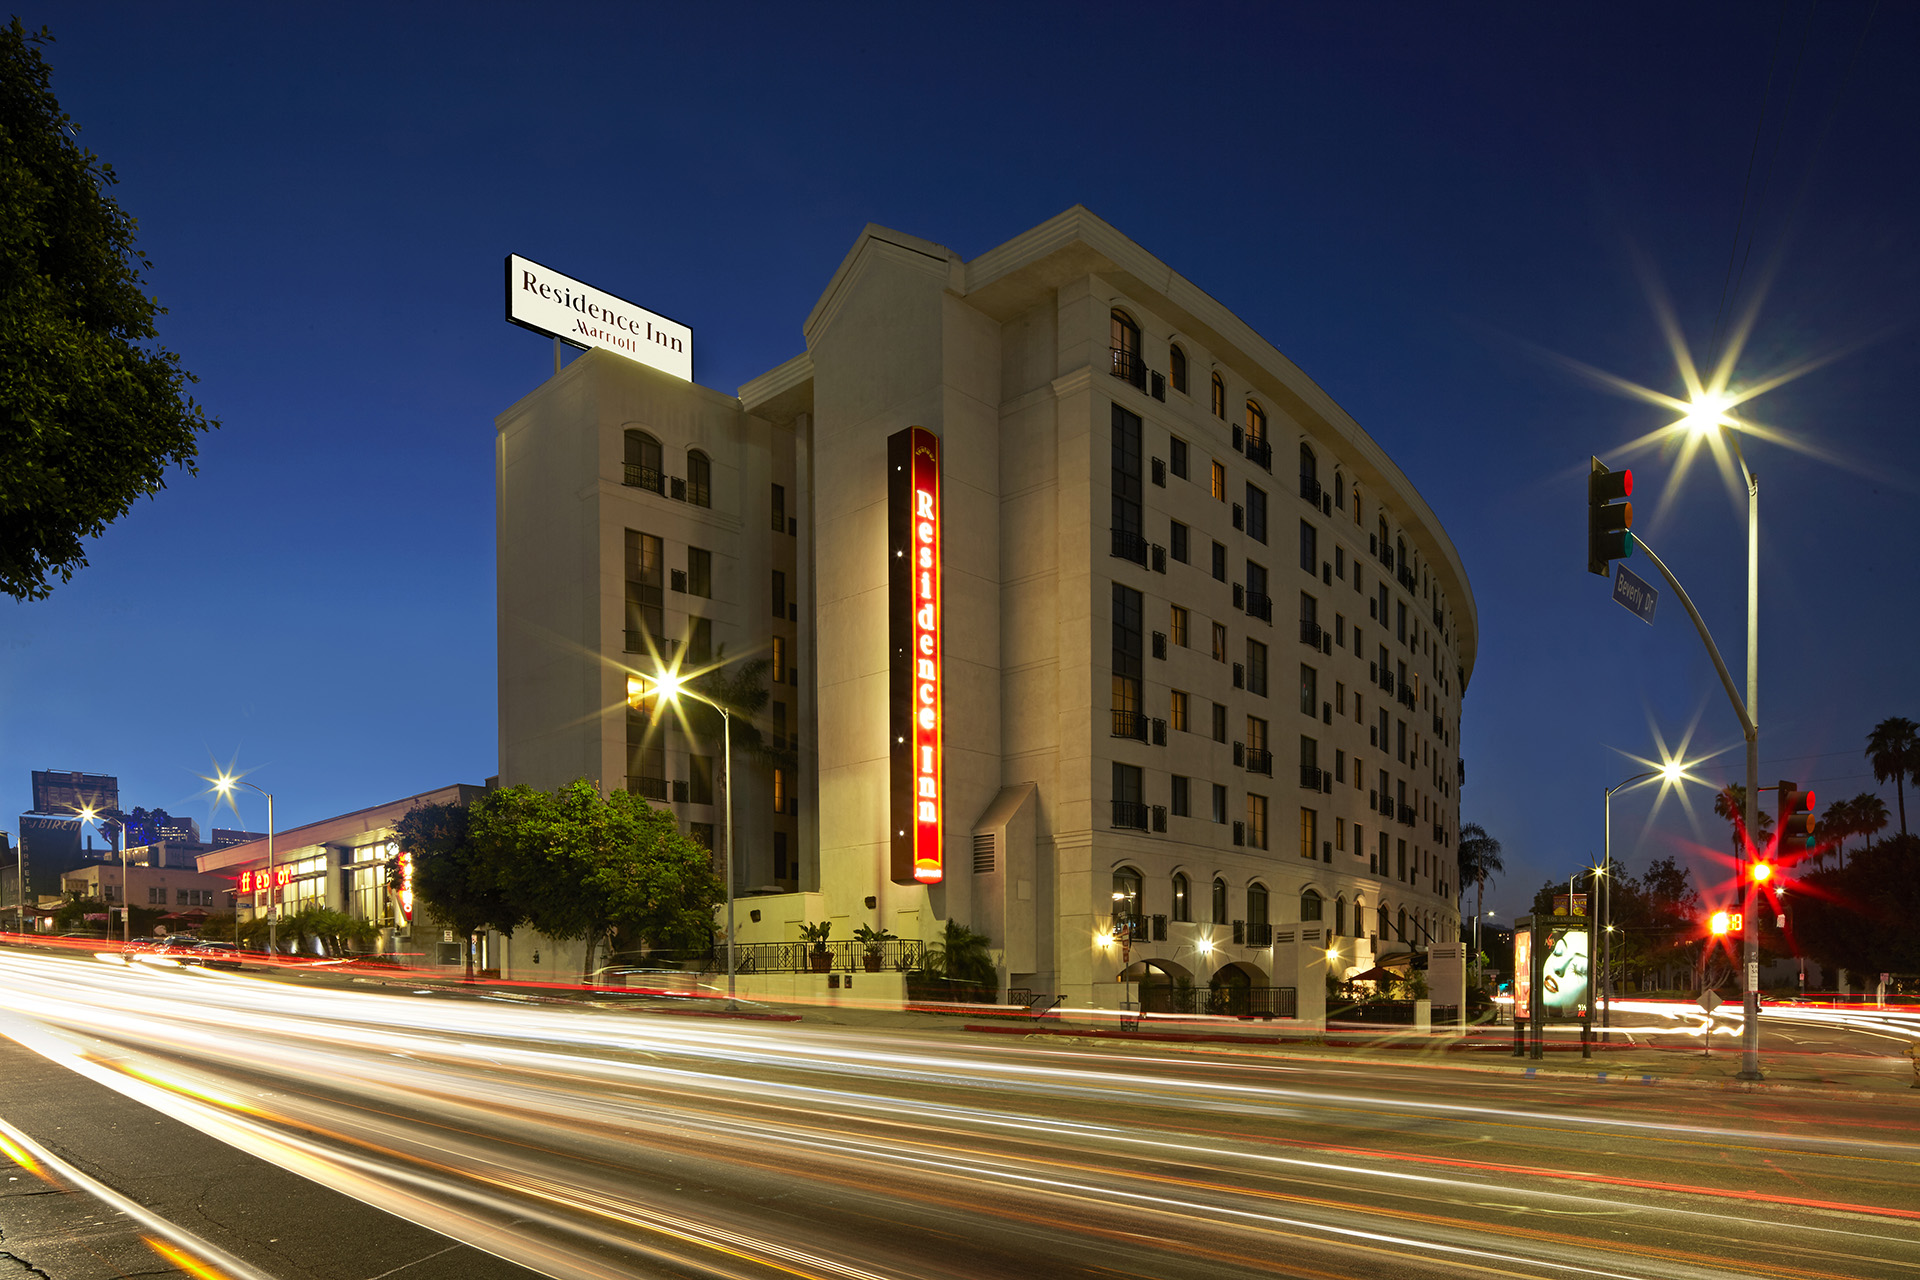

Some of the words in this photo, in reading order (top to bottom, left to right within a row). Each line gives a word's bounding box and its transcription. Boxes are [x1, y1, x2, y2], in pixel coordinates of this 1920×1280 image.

[522, 269, 640, 336] Residence
[646, 321, 684, 354] Inn
[571, 318, 637, 353] Marriott
[916, 489, 936, 730] Residence
[1617, 573, 1644, 610] Beverly
[1644, 592, 1654, 613] Dr
[918, 746, 937, 823] Inn
[22, 837, 31, 893] CARPETS
